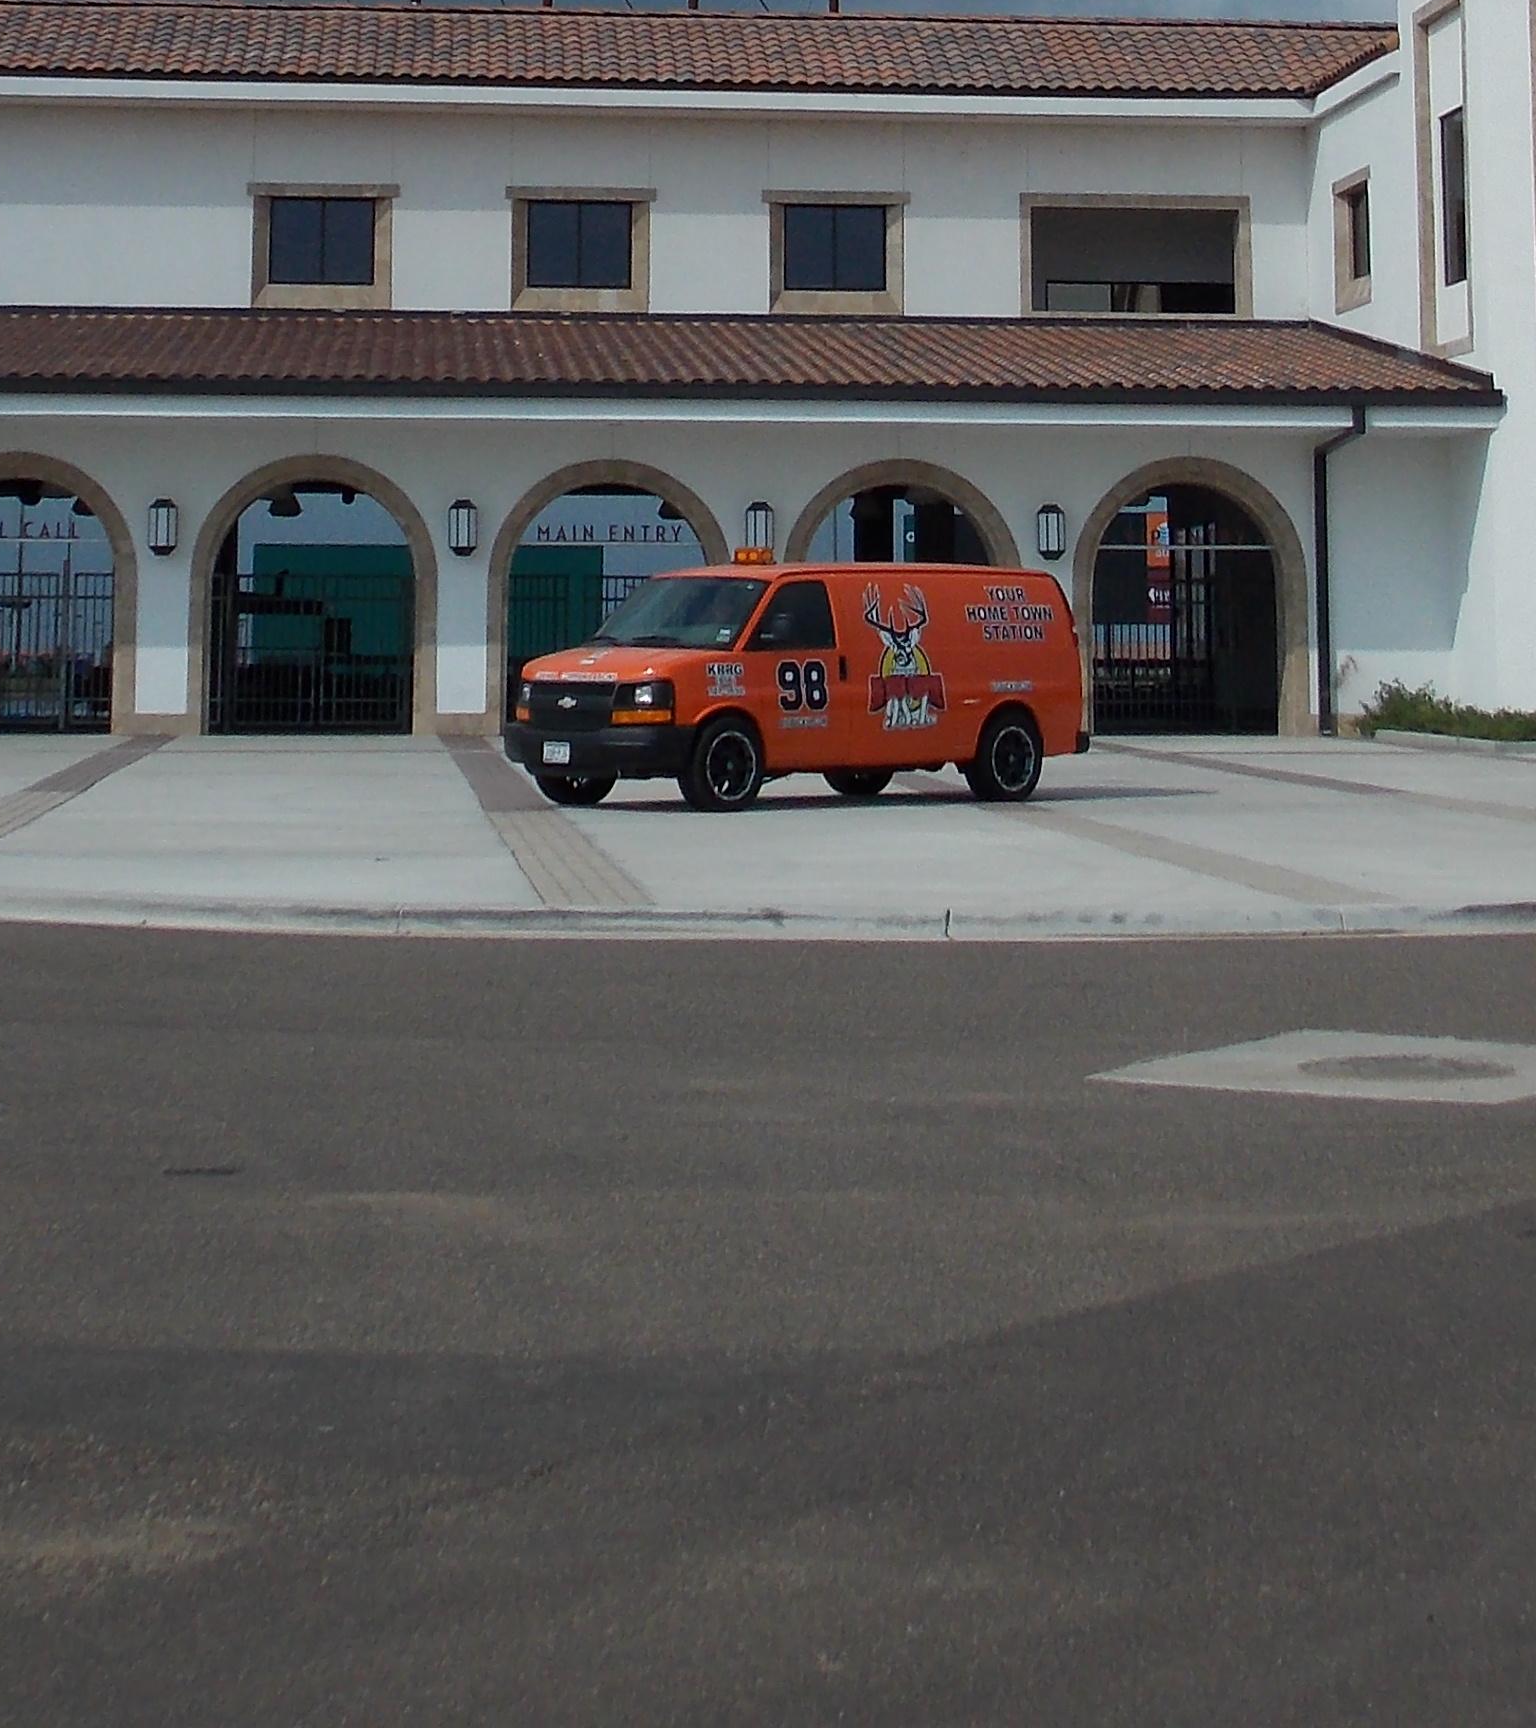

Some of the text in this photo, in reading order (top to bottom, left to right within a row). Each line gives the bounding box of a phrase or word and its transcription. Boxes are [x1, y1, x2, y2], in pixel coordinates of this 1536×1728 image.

[22, 521, 80, 539] CALL
[537, 524, 682, 542] MAIN ENTRY
[985, 587, 1025, 602] YOUR
[965, 605, 1054, 622] HOME TOWN
[983, 624, 1044, 641] STATION
[776, 659, 829, 712] 98
